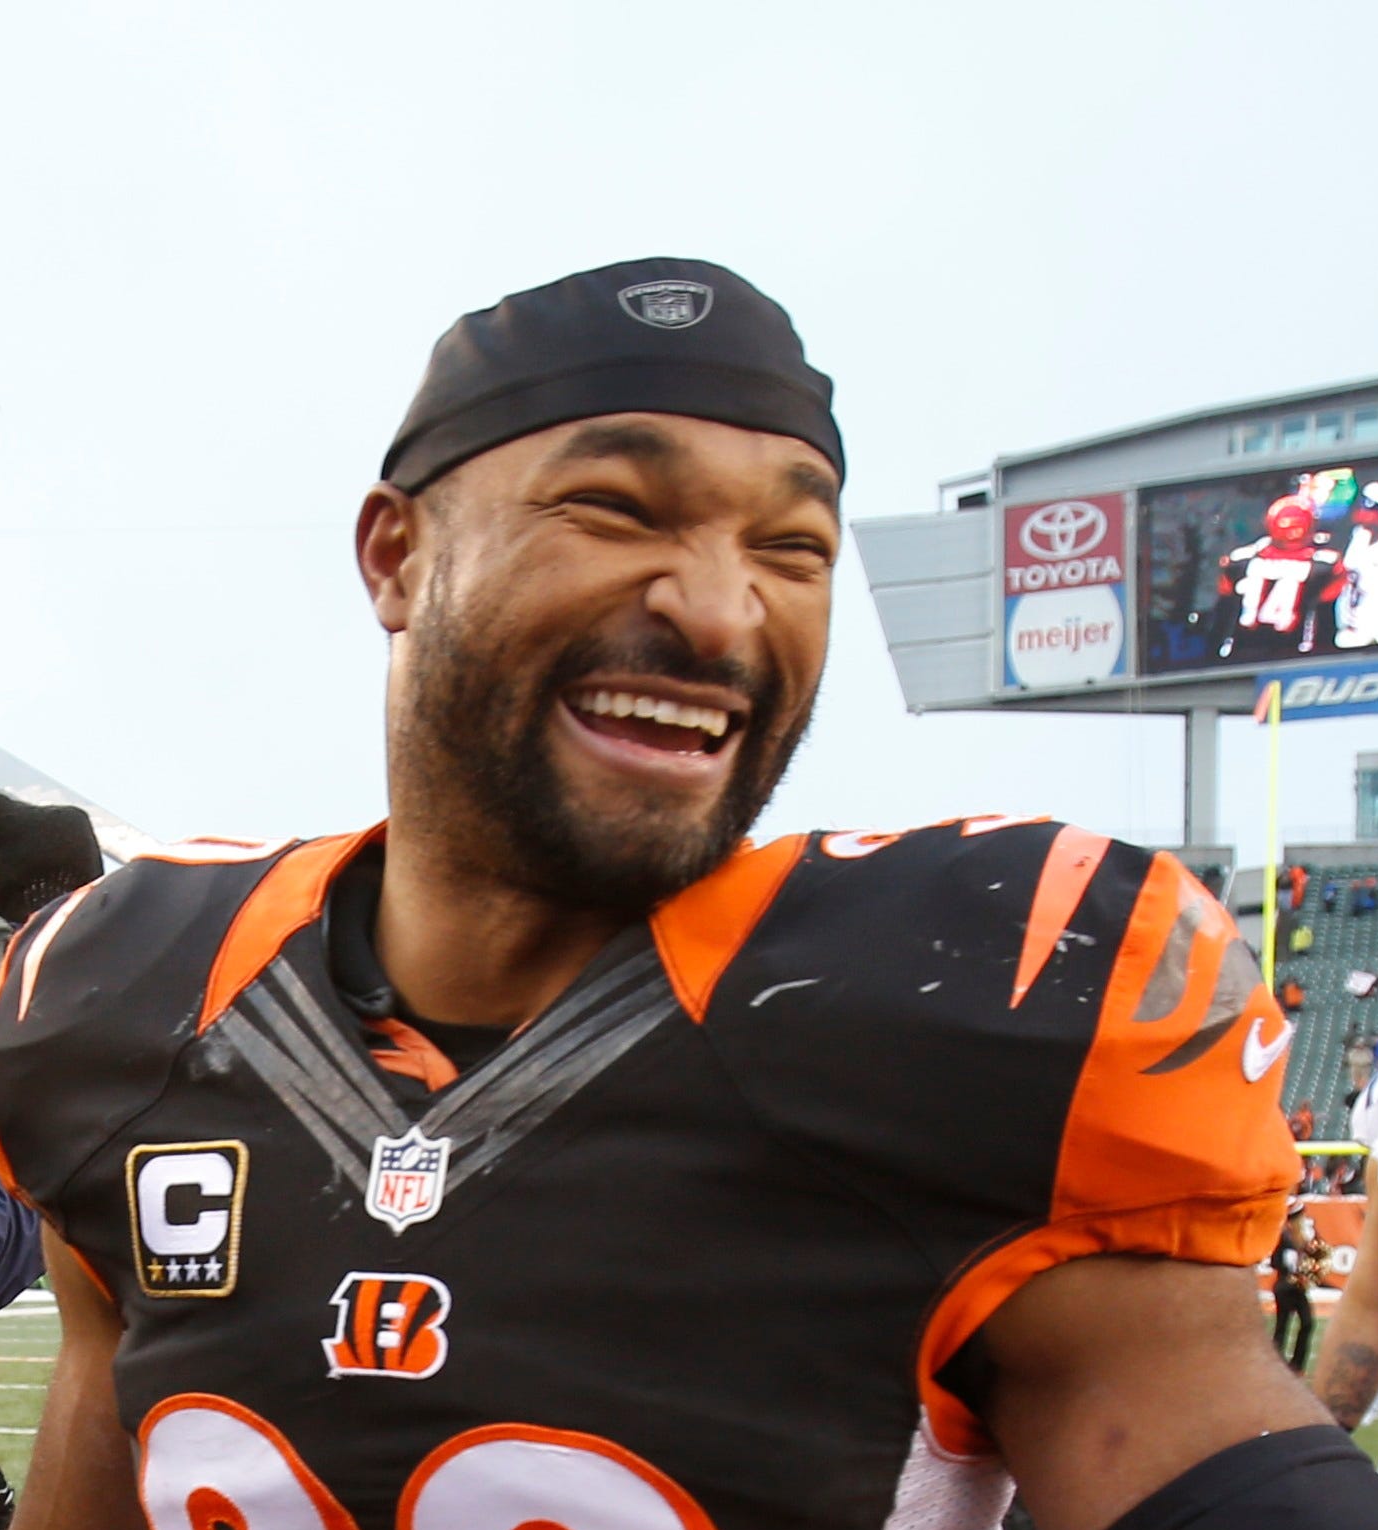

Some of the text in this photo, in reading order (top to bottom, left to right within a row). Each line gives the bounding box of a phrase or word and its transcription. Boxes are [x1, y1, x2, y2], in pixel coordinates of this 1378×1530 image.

[1007, 555, 1122, 590] TOYOTA
[1017, 616, 1114, 653] meijer
[138, 1152, 234, 1255] C
[379, 1174, 430, 1212] NFL
